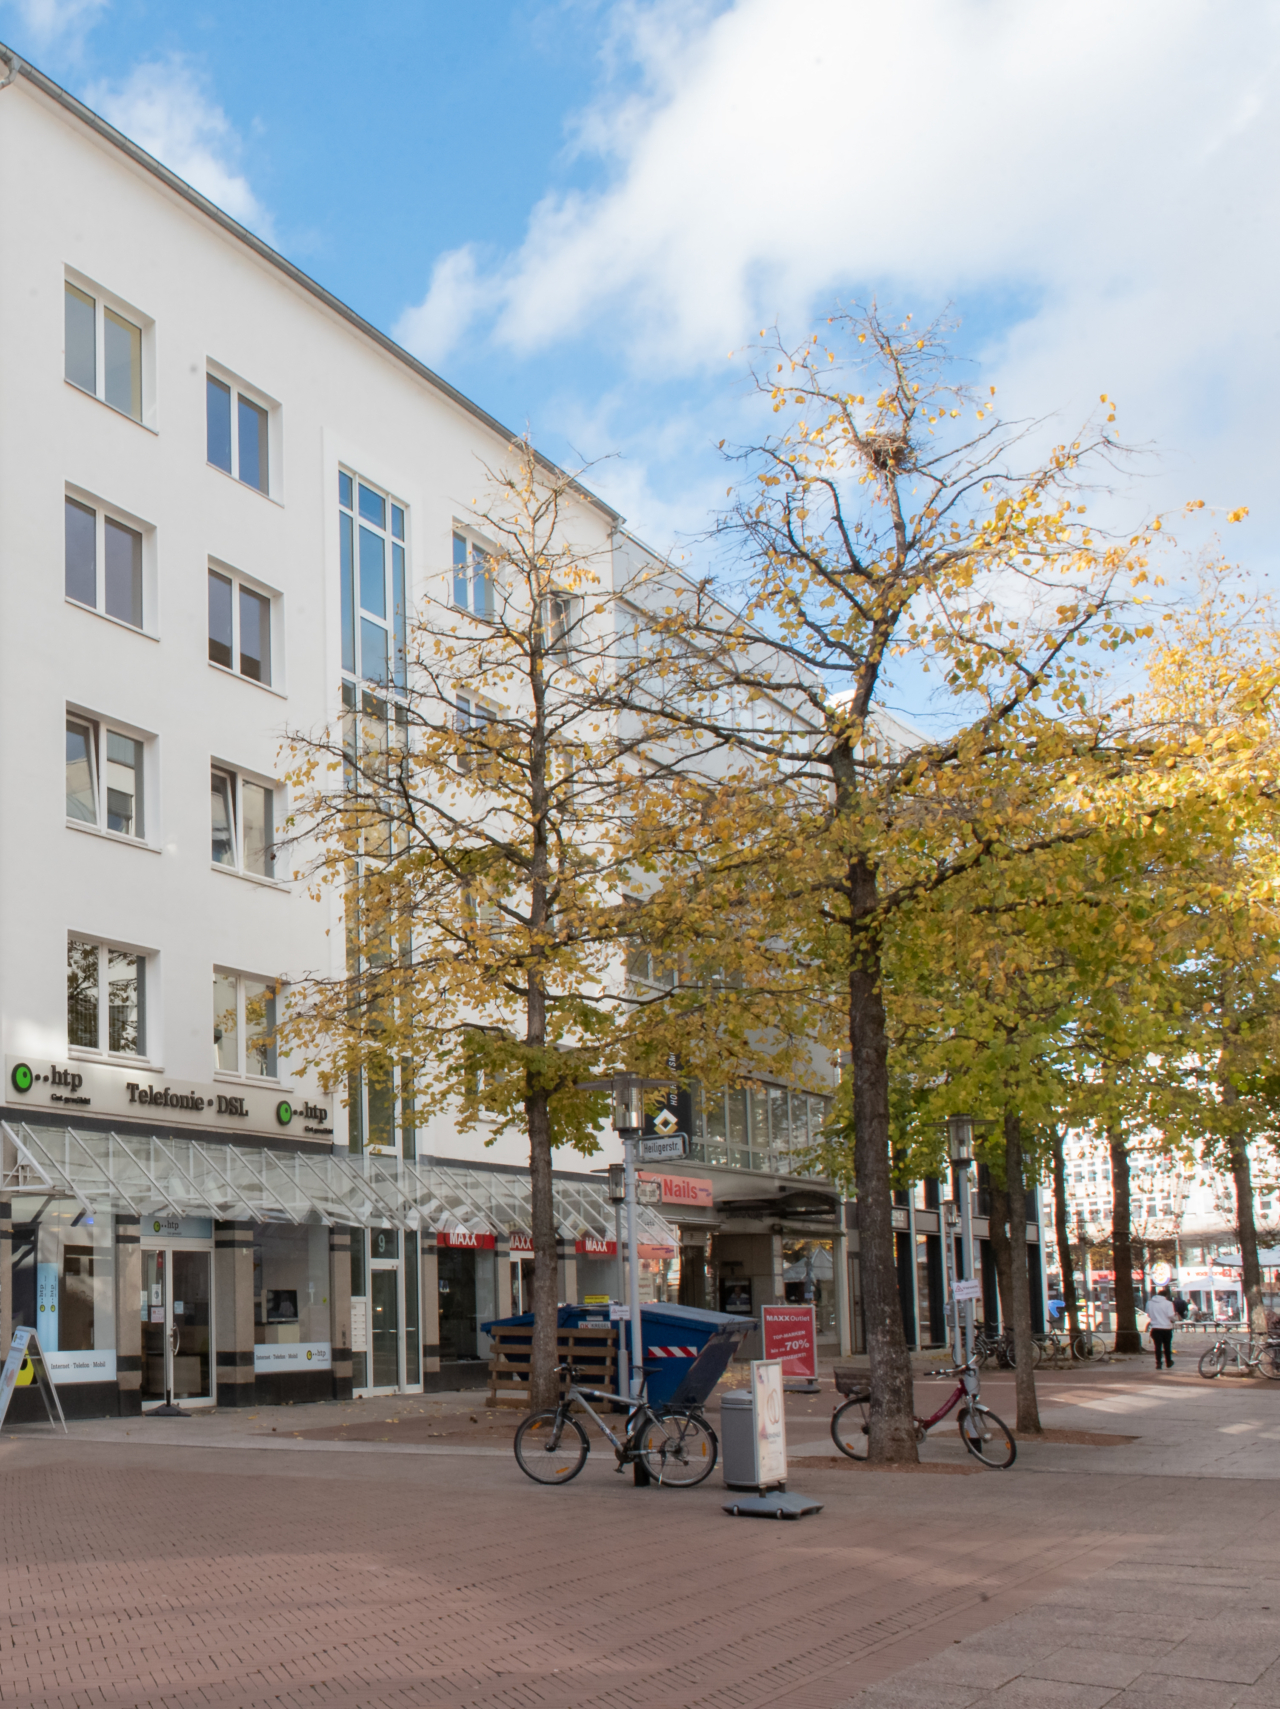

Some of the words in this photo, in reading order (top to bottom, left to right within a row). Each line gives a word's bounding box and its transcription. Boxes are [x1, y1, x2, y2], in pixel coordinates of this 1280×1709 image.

[51, 1065, 83, 1092] htp
[127, 1082, 205, 1111] Telefonie
[217, 1094, 248, 1117] DSL
[304, 1101, 327, 1124] htp
[643, 1141, 680, 1155] Heiligerstr.
[663, 1178, 698, 1199] Nails
[167, 1220, 179, 1231] htp
[378, 1234, 386, 1253] 9
[450, 1230, 477, 1246] MAXX
[586, 1238, 608, 1252] MAXX
[773, 1330, 806, 1340] TOP-MARKEN
[785, 1339, 810, 1351] 70%
